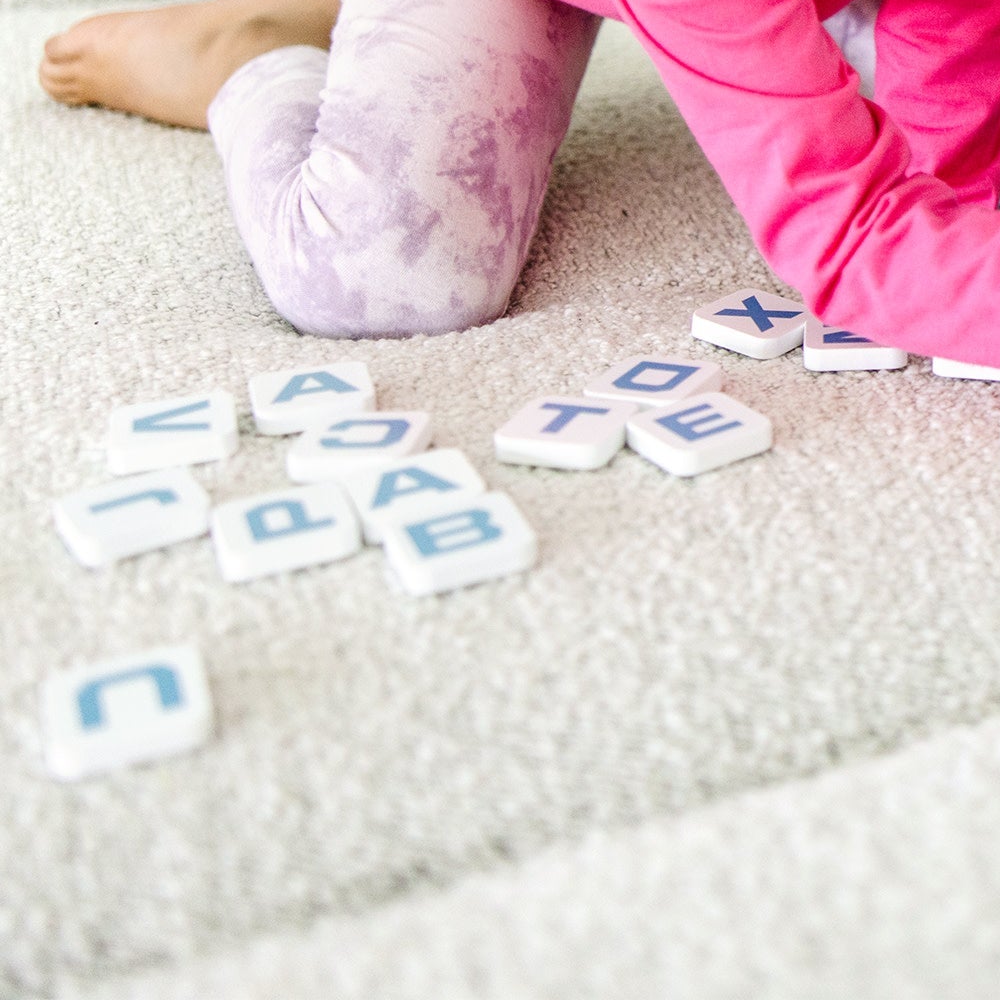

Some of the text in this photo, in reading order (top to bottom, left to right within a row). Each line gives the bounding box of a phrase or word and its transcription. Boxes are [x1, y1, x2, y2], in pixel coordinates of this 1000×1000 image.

[713, 295, 804, 332] X
[272, 371, 360, 404] A
[131, 399, 211, 433] V
[541, 403, 611, 434] T
[655, 403, 744, 443] E
[369, 466, 463, 511] A
[245, 499, 336, 543] P
[402, 508, 504, 558] B
